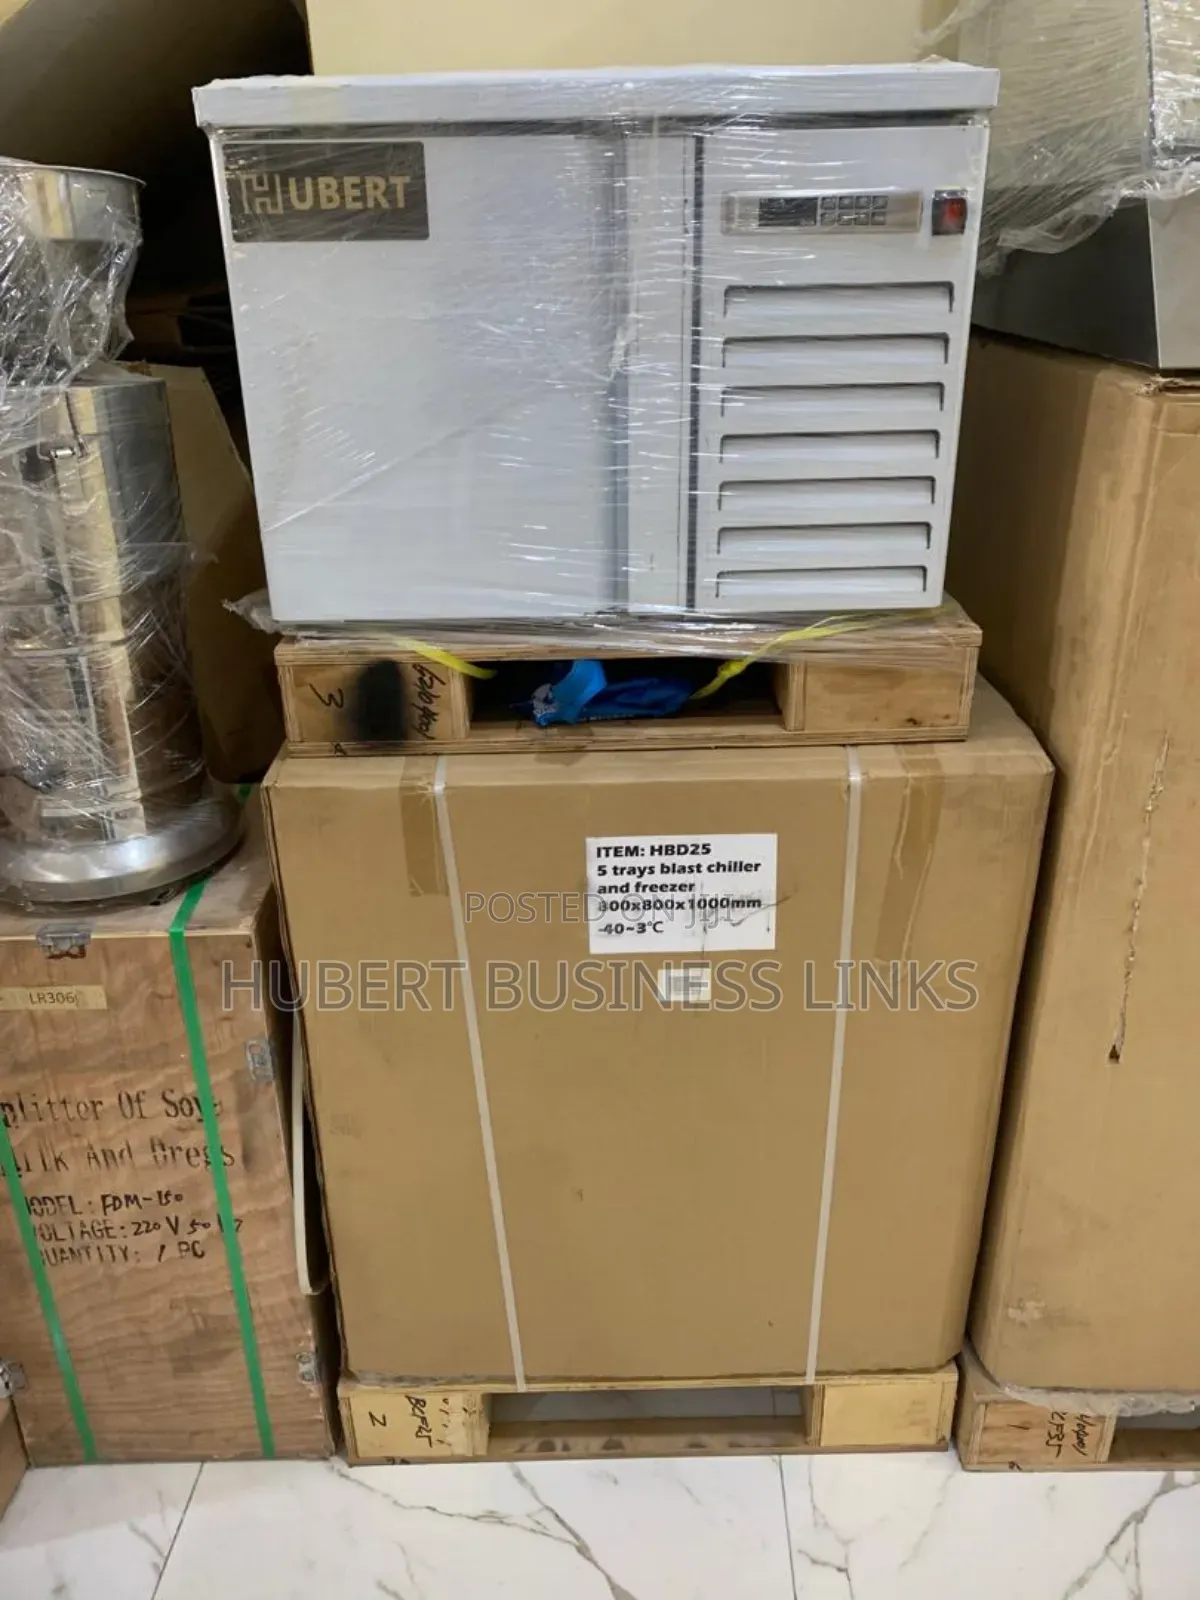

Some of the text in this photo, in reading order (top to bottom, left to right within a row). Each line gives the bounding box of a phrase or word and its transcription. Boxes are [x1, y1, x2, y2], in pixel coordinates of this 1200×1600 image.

[238, 172, 410, 215] HUBERT
[596, 843, 712, 859] ITEM: HBD25
[597, 860, 762, 878] 5 trays blast chiller
[597, 880, 696, 895] and freezer
[118, 1090, 147, 1120] Of
